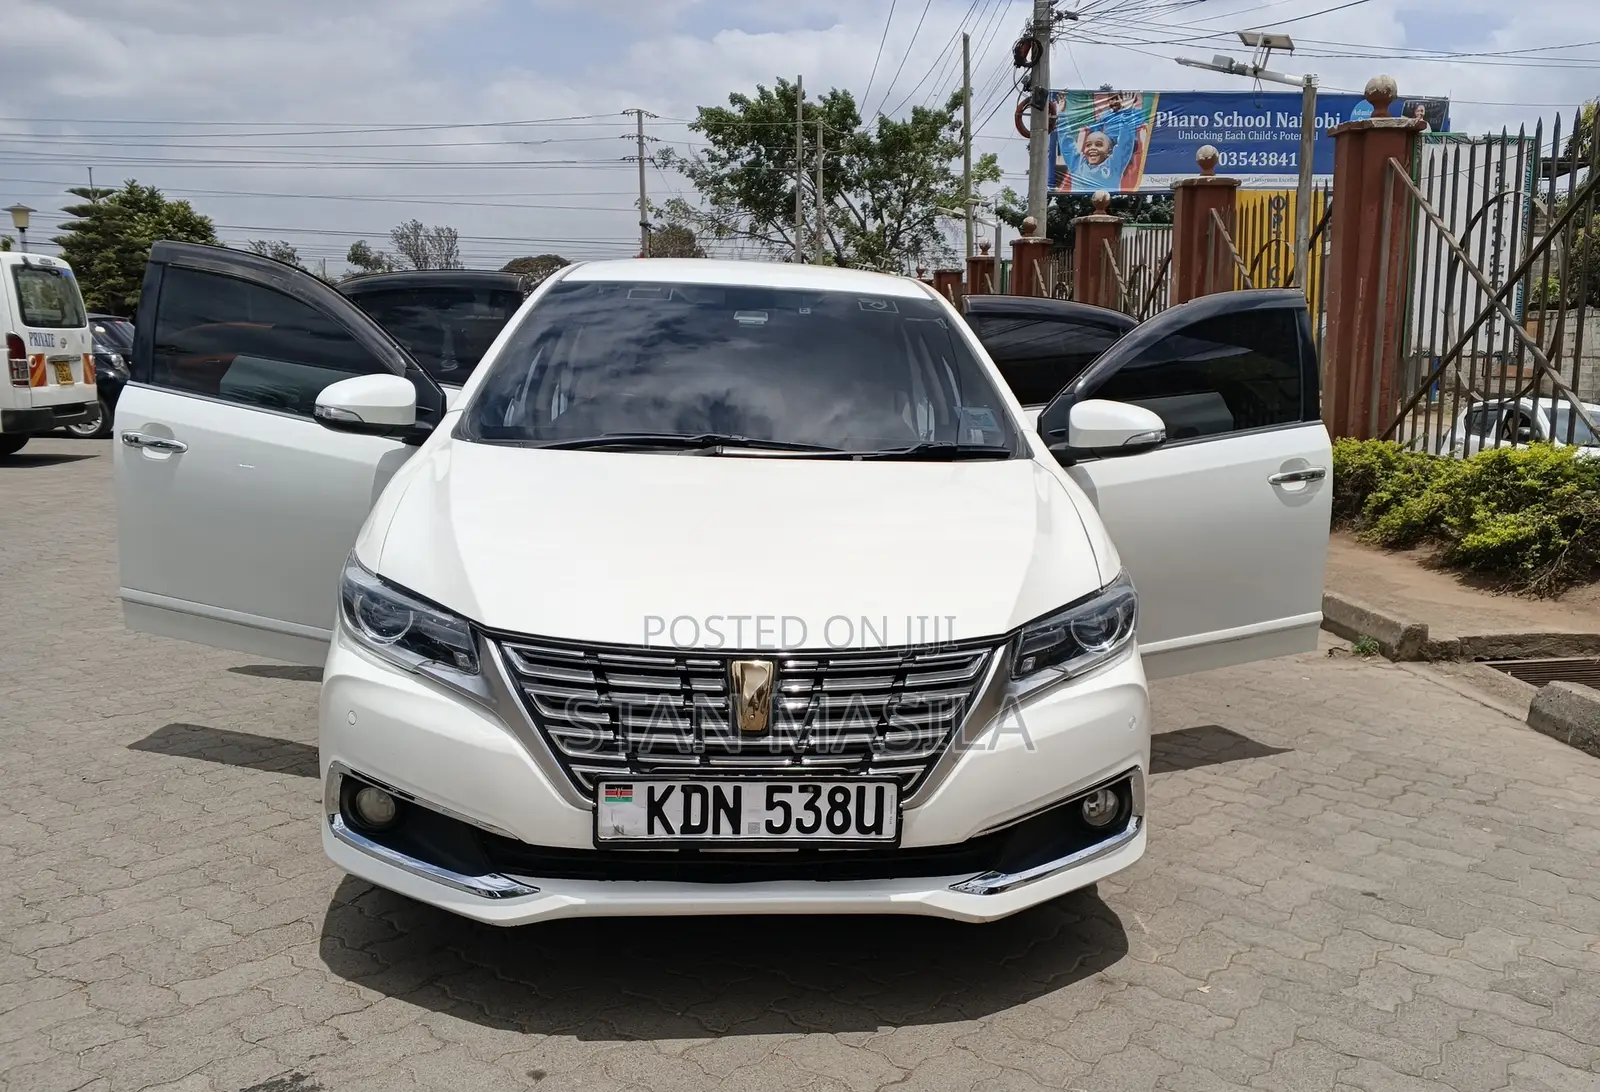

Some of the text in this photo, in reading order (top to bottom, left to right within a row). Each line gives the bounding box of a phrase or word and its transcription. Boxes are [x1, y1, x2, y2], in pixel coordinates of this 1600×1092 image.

[1156, 111, 1340, 129] Pharo School Naiobi
[1178, 130, 1223, 142] Unlocking
[1225, 131, 1246, 140] Each
[1248, 131, 1278, 141] Child's
[28, 332, 55, 347] PRIVATE
[647, 784, 742, 835] KDN
[765, 784, 885, 835] 538U
